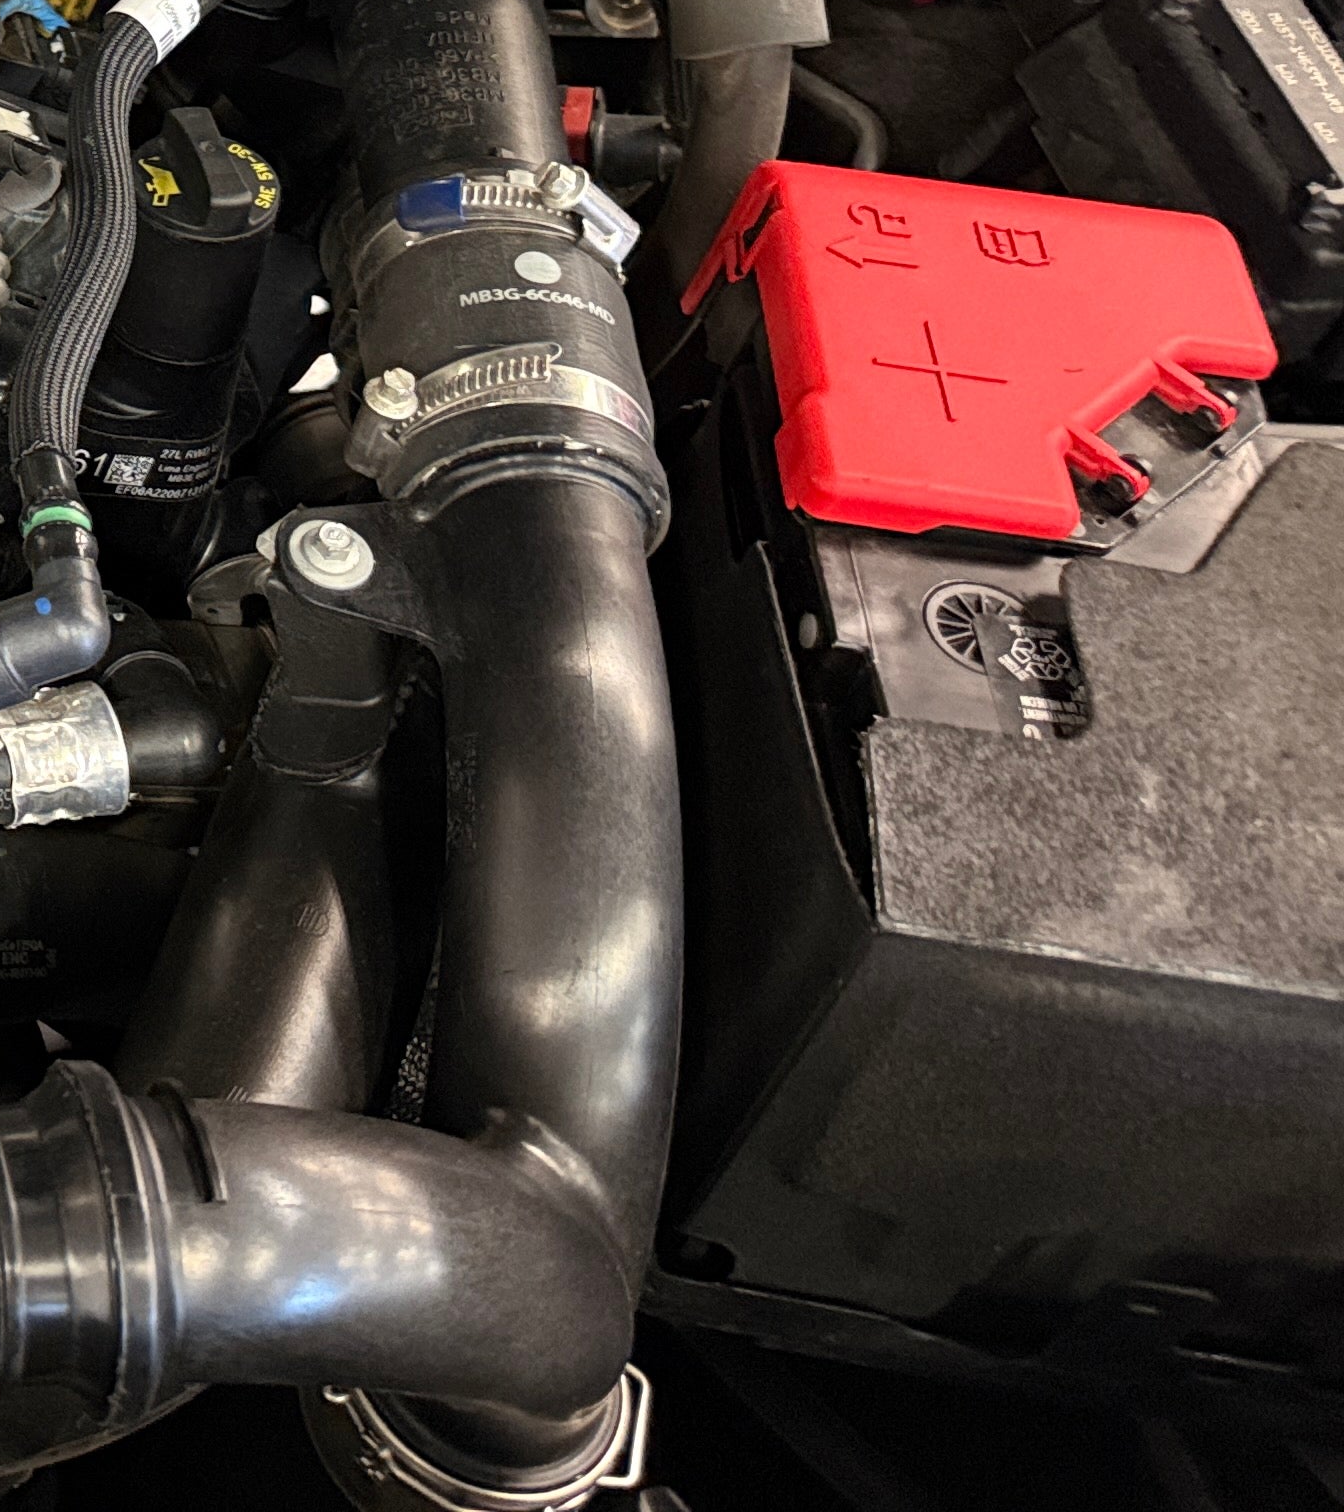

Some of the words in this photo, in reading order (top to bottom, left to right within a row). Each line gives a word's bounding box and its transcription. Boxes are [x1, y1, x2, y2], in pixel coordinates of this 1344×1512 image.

[227, 143, 275, 181] 5W-30
[254, 185, 277, 209] SAE
[459, 287, 616, 326] MB3G-6C646-MD
